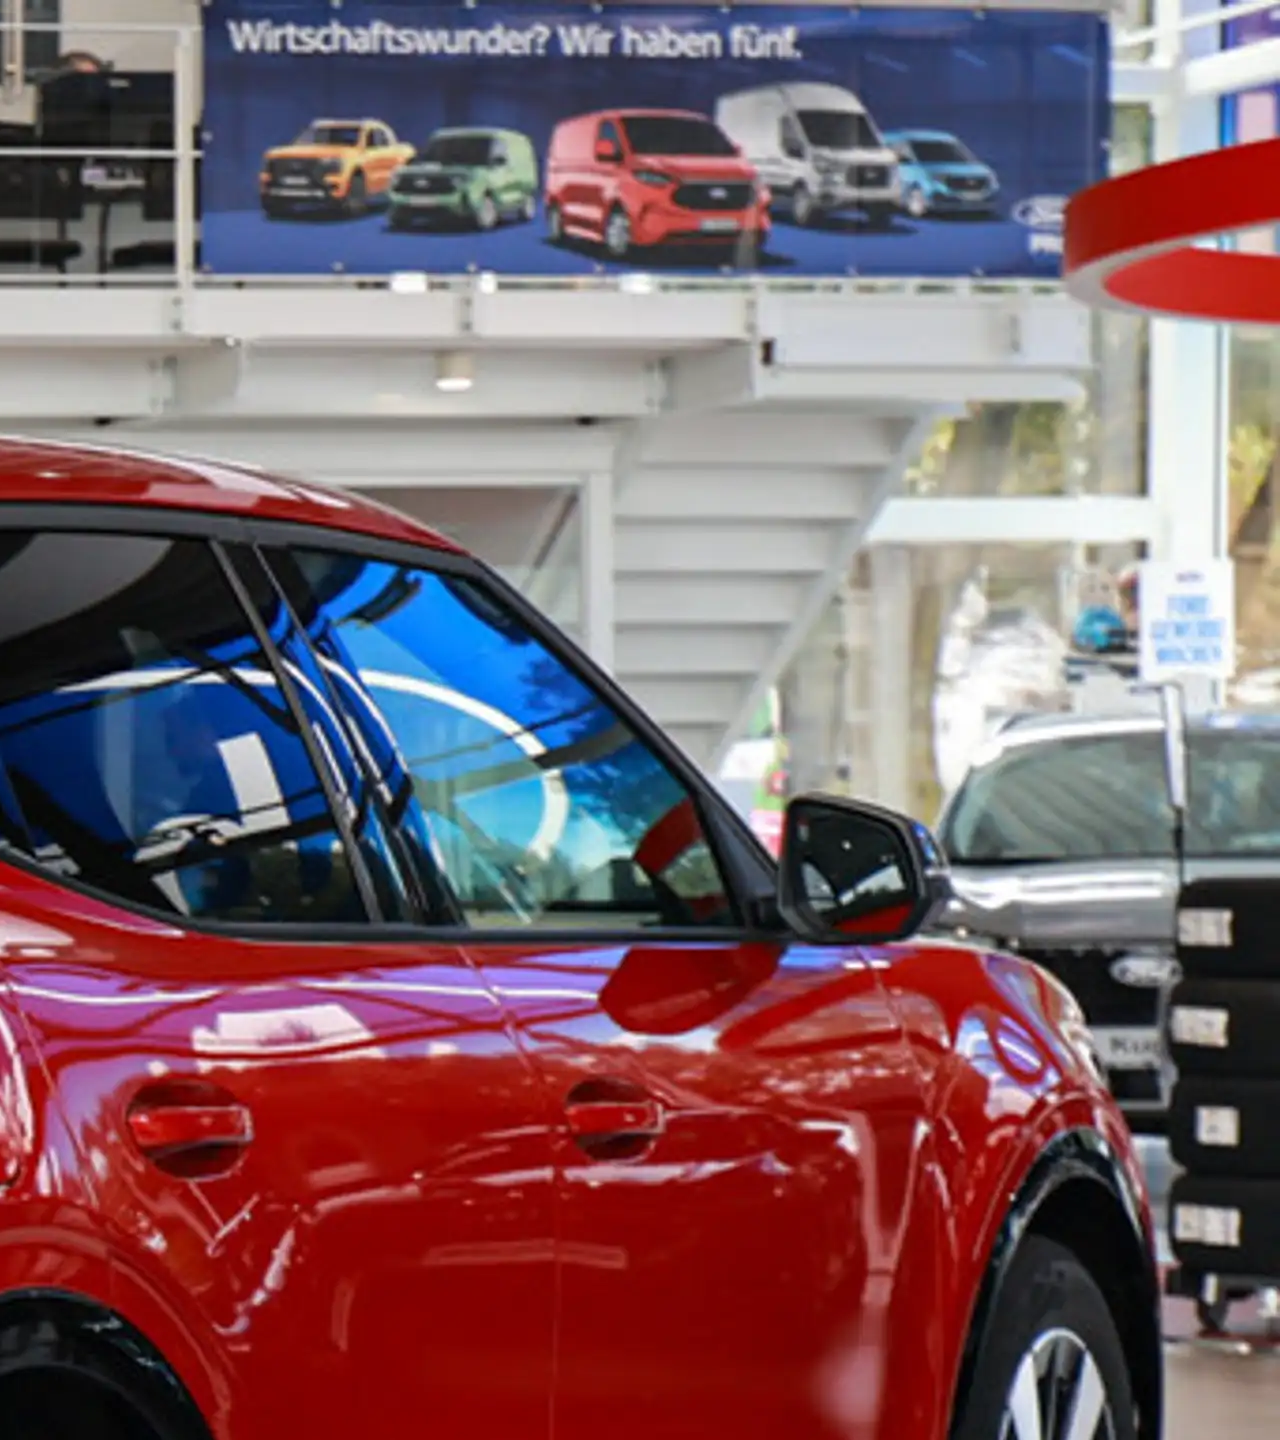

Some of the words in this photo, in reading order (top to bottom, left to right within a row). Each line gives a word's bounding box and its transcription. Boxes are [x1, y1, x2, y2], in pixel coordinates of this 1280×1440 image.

[225, 18, 550, 56] Wirtschaftswunder?
[556, 23, 614, 57] Wir
[620, 23, 723, 59] haben
[729, 24, 803, 60] fünf.
